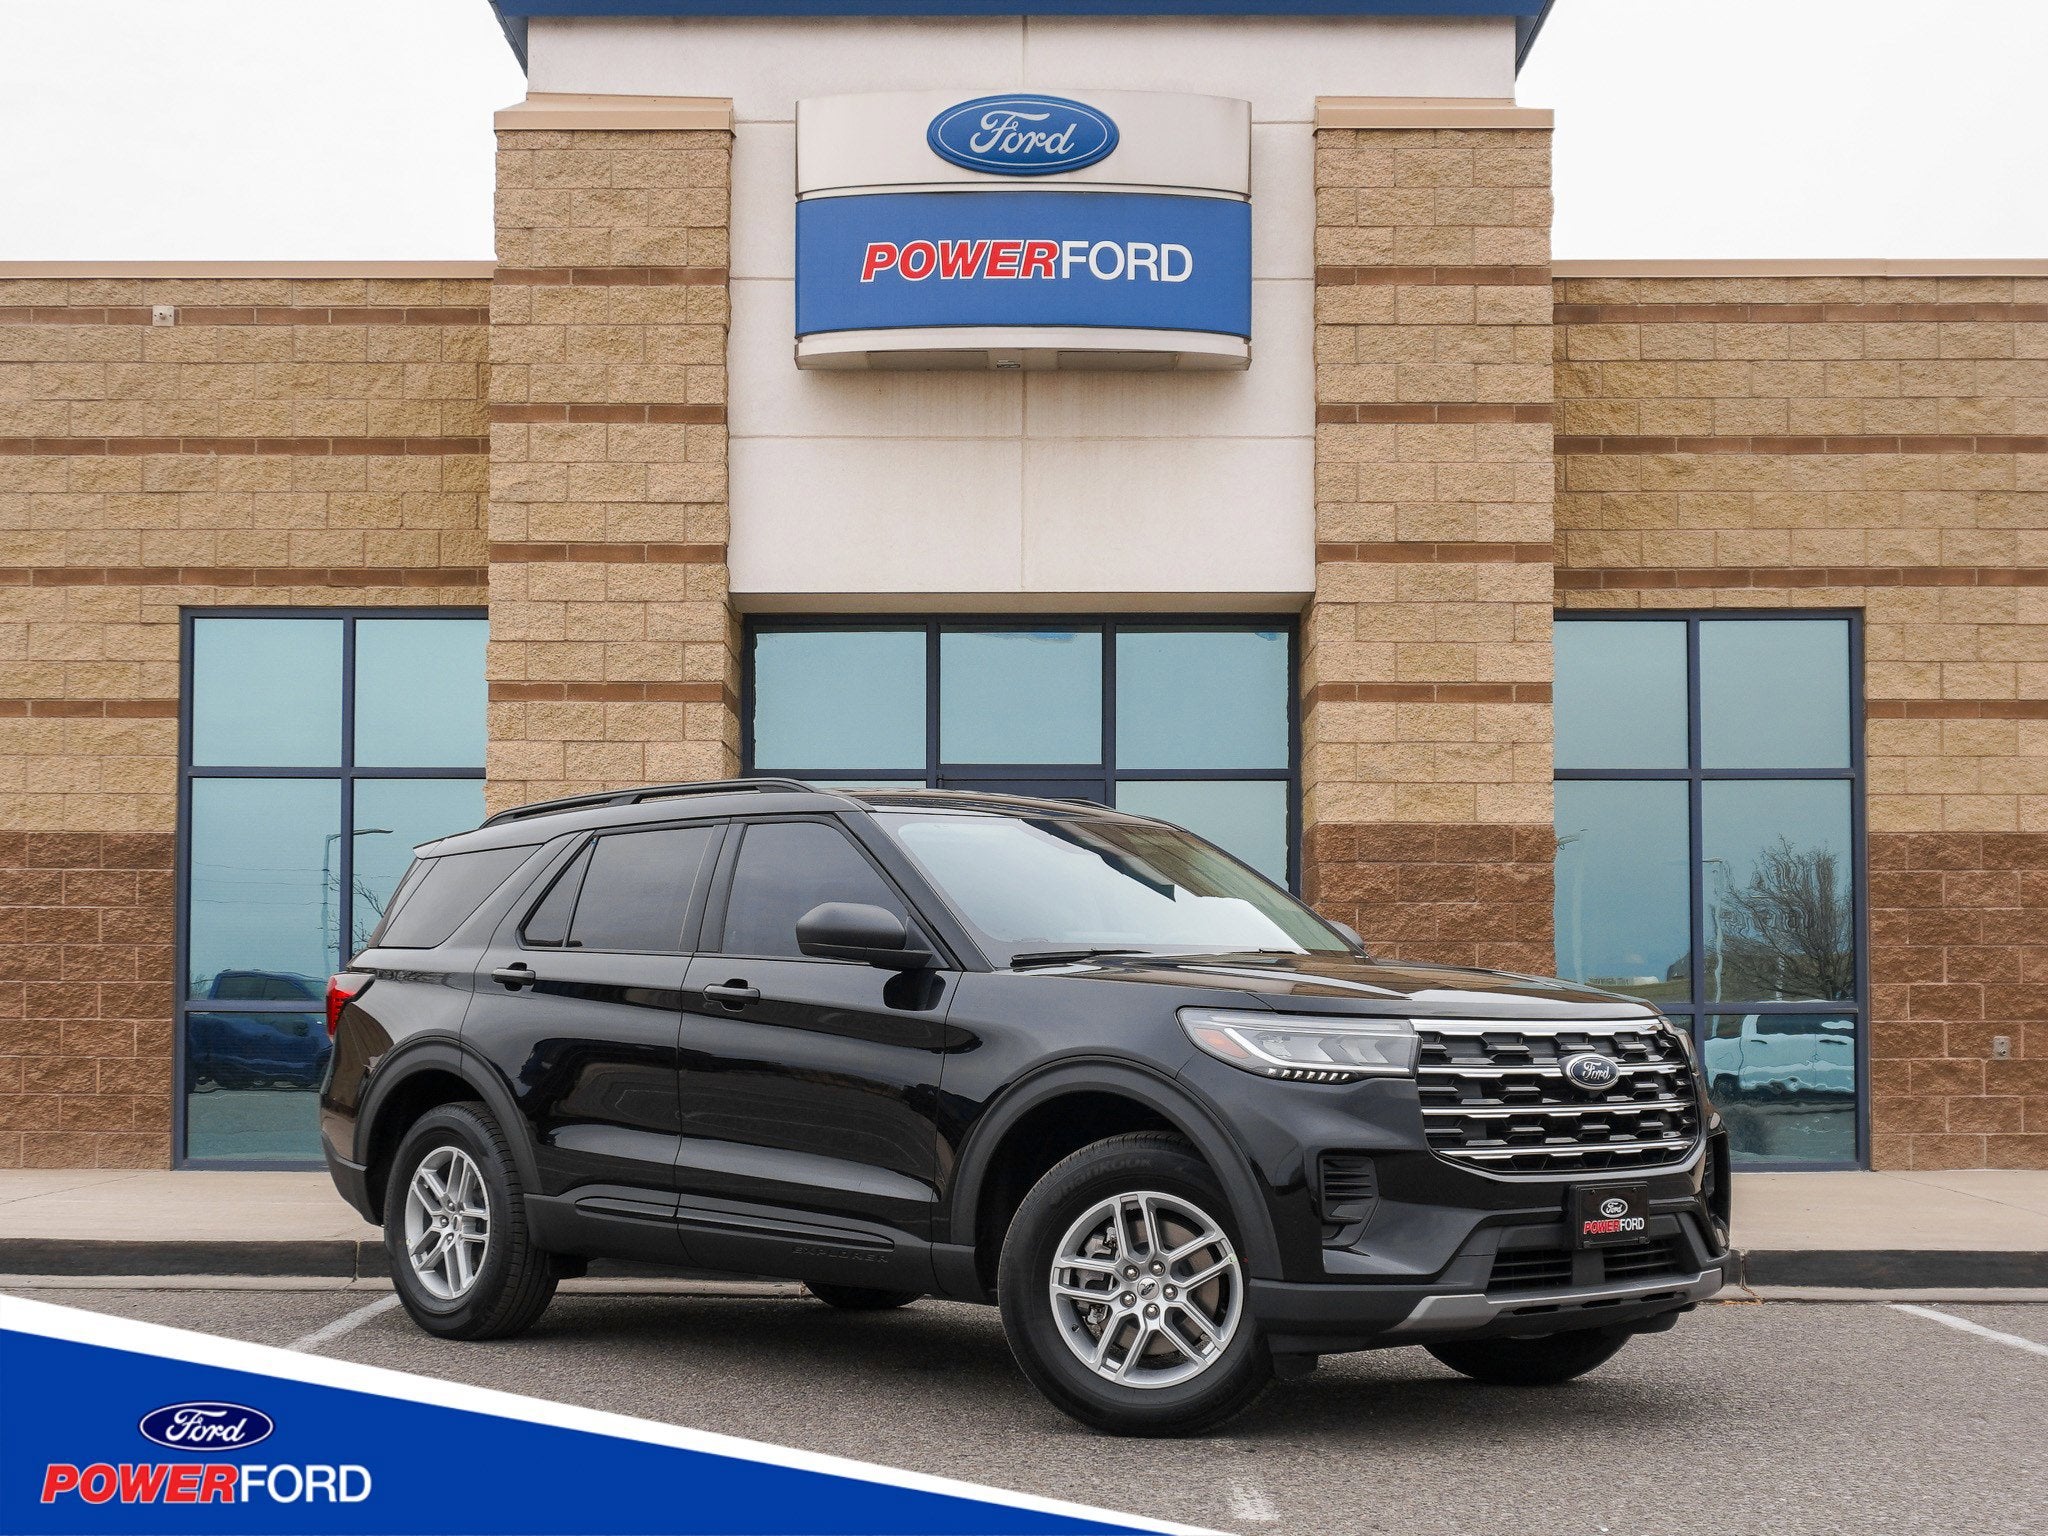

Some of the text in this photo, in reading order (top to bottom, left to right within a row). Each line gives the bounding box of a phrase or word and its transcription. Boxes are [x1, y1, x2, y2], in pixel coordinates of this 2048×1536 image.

[970, 110, 1077, 155] Ford
[860, 239, 1193, 283] POWERFORD
[1582, 1061, 1610, 1080] Ford
[1583, 1217, 1645, 1235] POWERFORD
